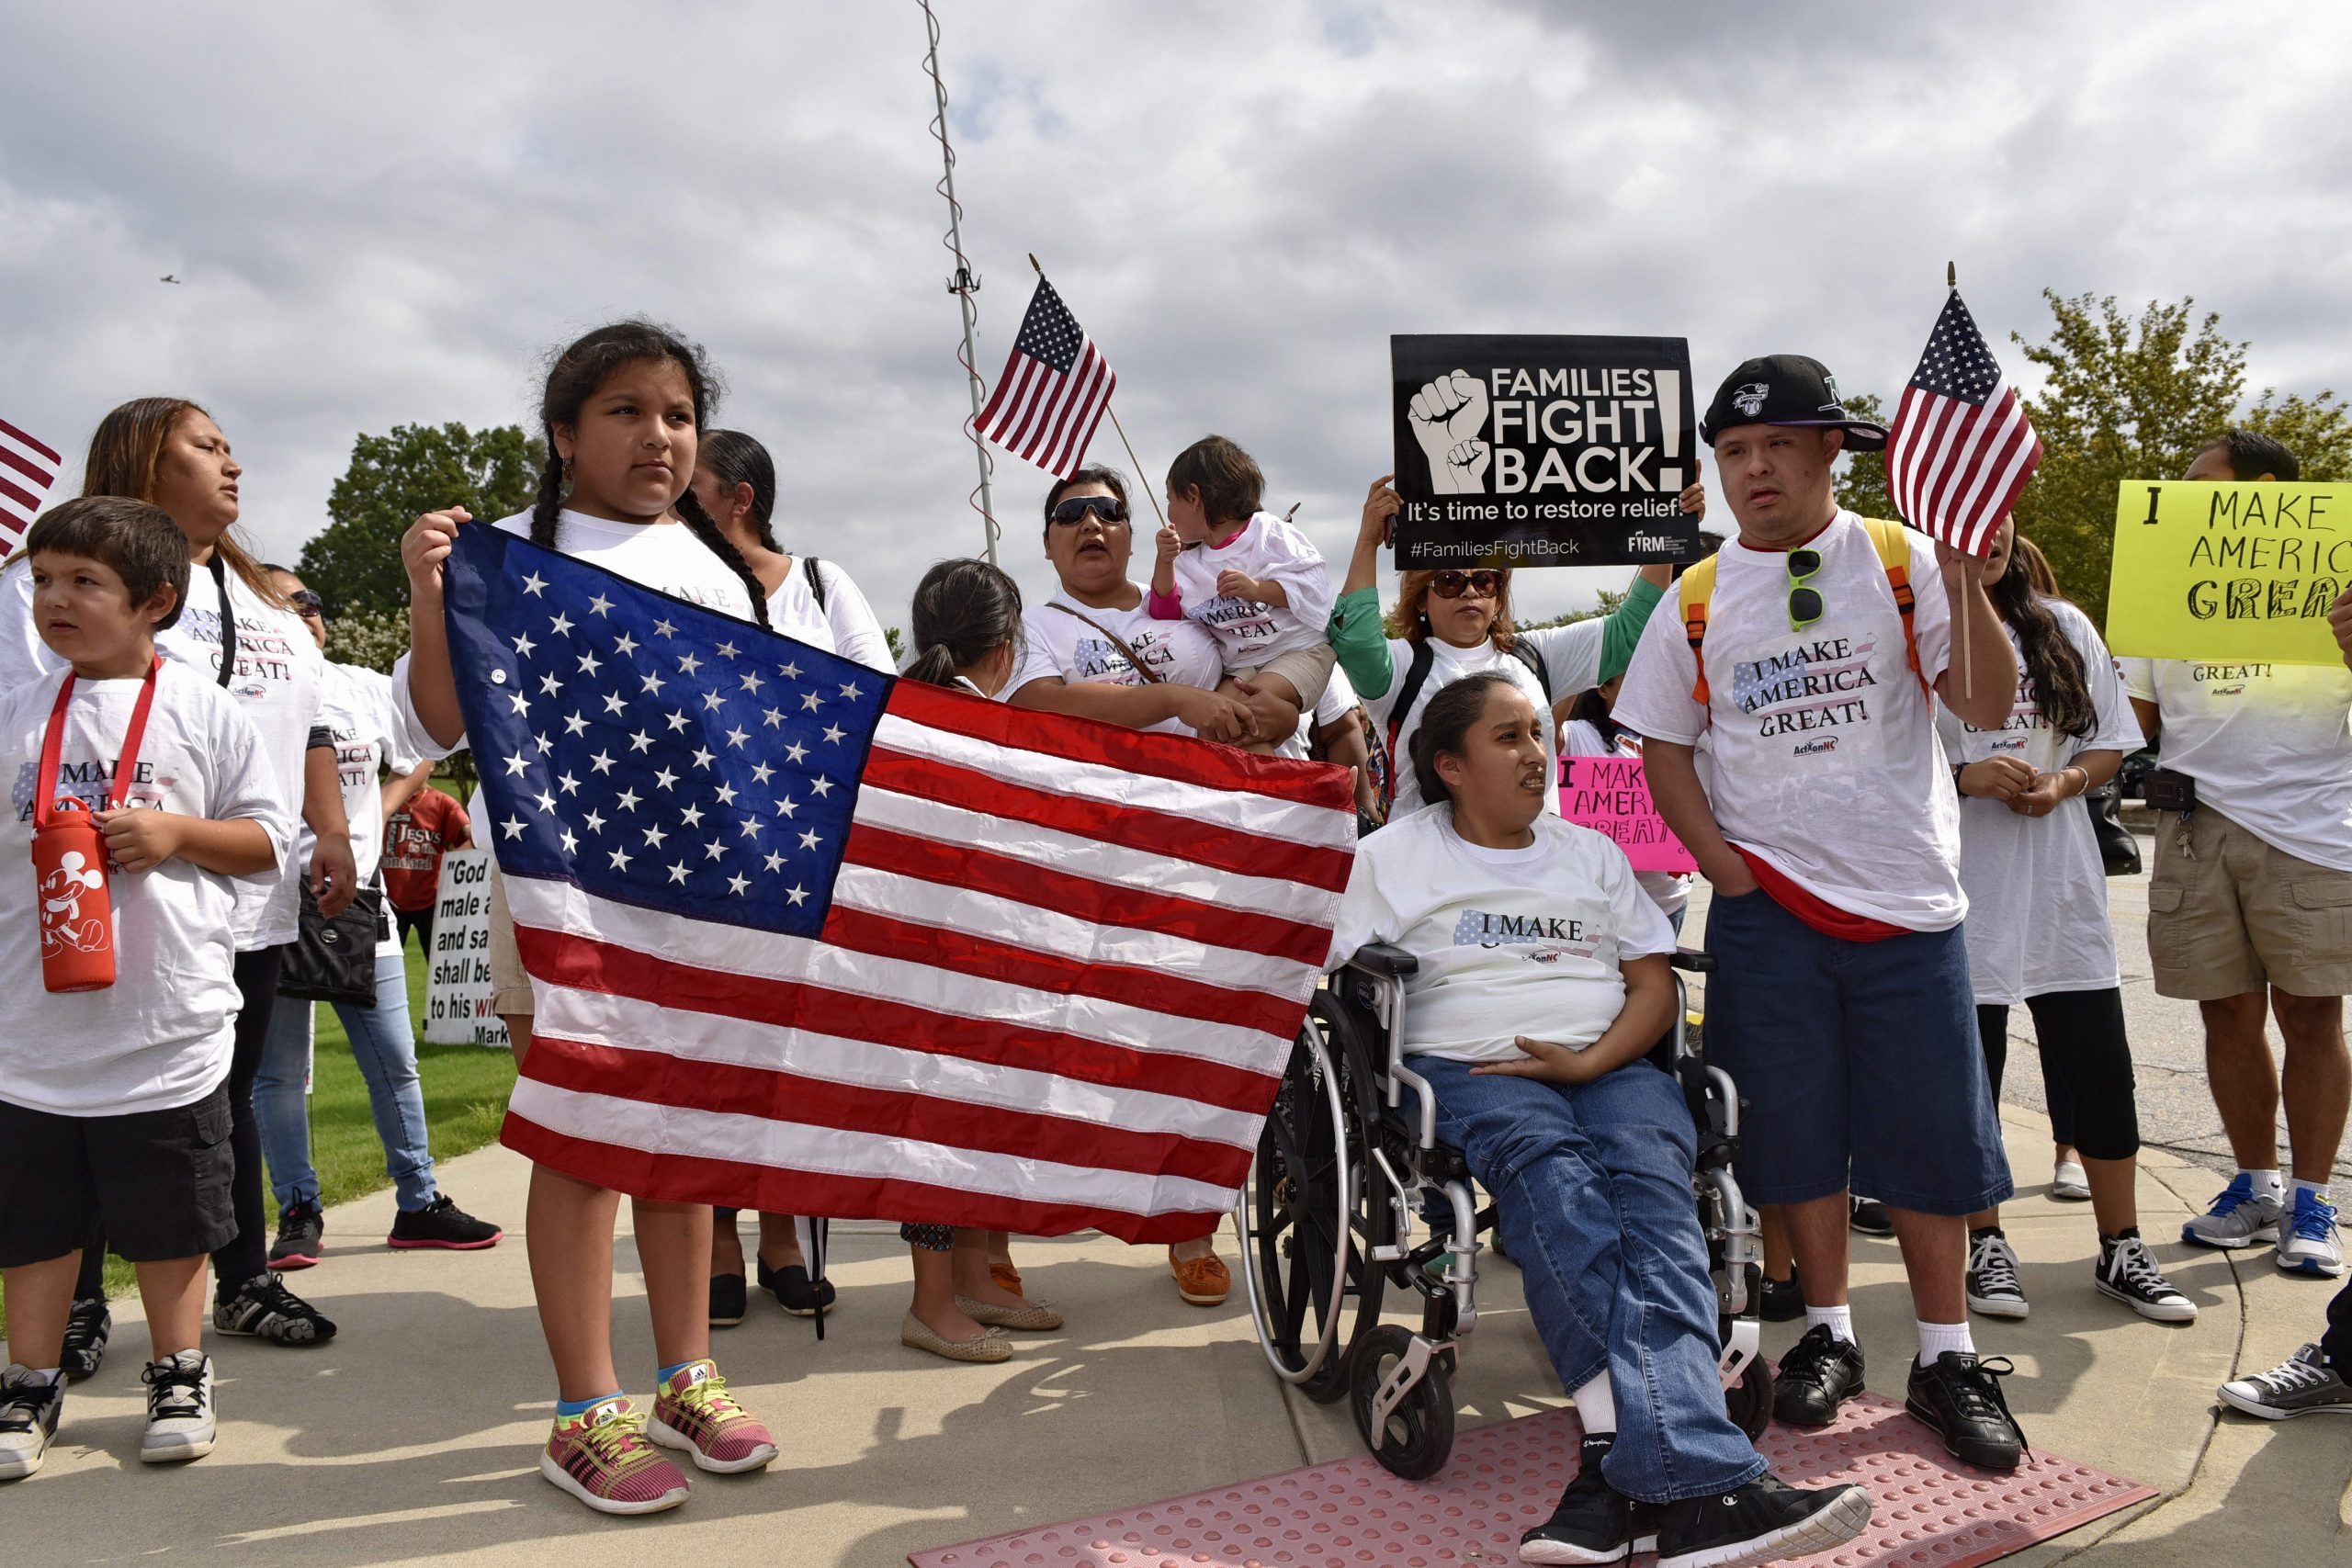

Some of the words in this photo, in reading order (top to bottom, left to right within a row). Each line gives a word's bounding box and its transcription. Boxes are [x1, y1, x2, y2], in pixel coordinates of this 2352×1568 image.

[1491, 368, 1653, 396] FAMILIES
[1493, 400, 1655, 444] FIGHT
[1408, 502, 1441, 522] It's
[1447, 501, 1499, 521] time
[1506, 502, 1529, 520] to
[1534, 501, 1615, 519] restore
[2143, 487, 2162, 525] I
[2209, 491, 2336, 532] MAKE
[1410, 539, 1579, 559] #FamiliesFightBack
[1628, 531, 1665, 552] FIRM
[2189, 536, 2352, 574] AMERIC
[662, 586, 730, 608] AKE
[2188, 577, 2352, 621] GREA
[193, 627, 296, 656] AMRICA
[1103, 631, 1157, 658] MKE
[210, 652, 290, 681] GEAT!
[1752, 660, 1763, 682] I
[1769, 638, 1852, 675] MAKE
[2193, 663, 2271, 682] GREAT!
[1745, 666, 1877, 715] AMERICA
[1759, 700, 1867, 737] GREAT!
[1558, 761, 1576, 788] I
[1591, 762, 1643, 789] MAK
[1574, 791, 1657, 816] AMER
[397, 824, 442, 844] JESUS
[447, 858, 488, 885] "God
[440, 892, 480, 918] male
[437, 925, 467, 952] and
[1482, 913, 1491, 934] I
[1498, 914, 1583, 942] MAKE
[434, 958, 470, 985] shall
[473, 957, 491, 983] be
[431, 994, 445, 1020] to
[449, 993, 470, 1019] his
[475, 1025, 508, 1044] Mark
